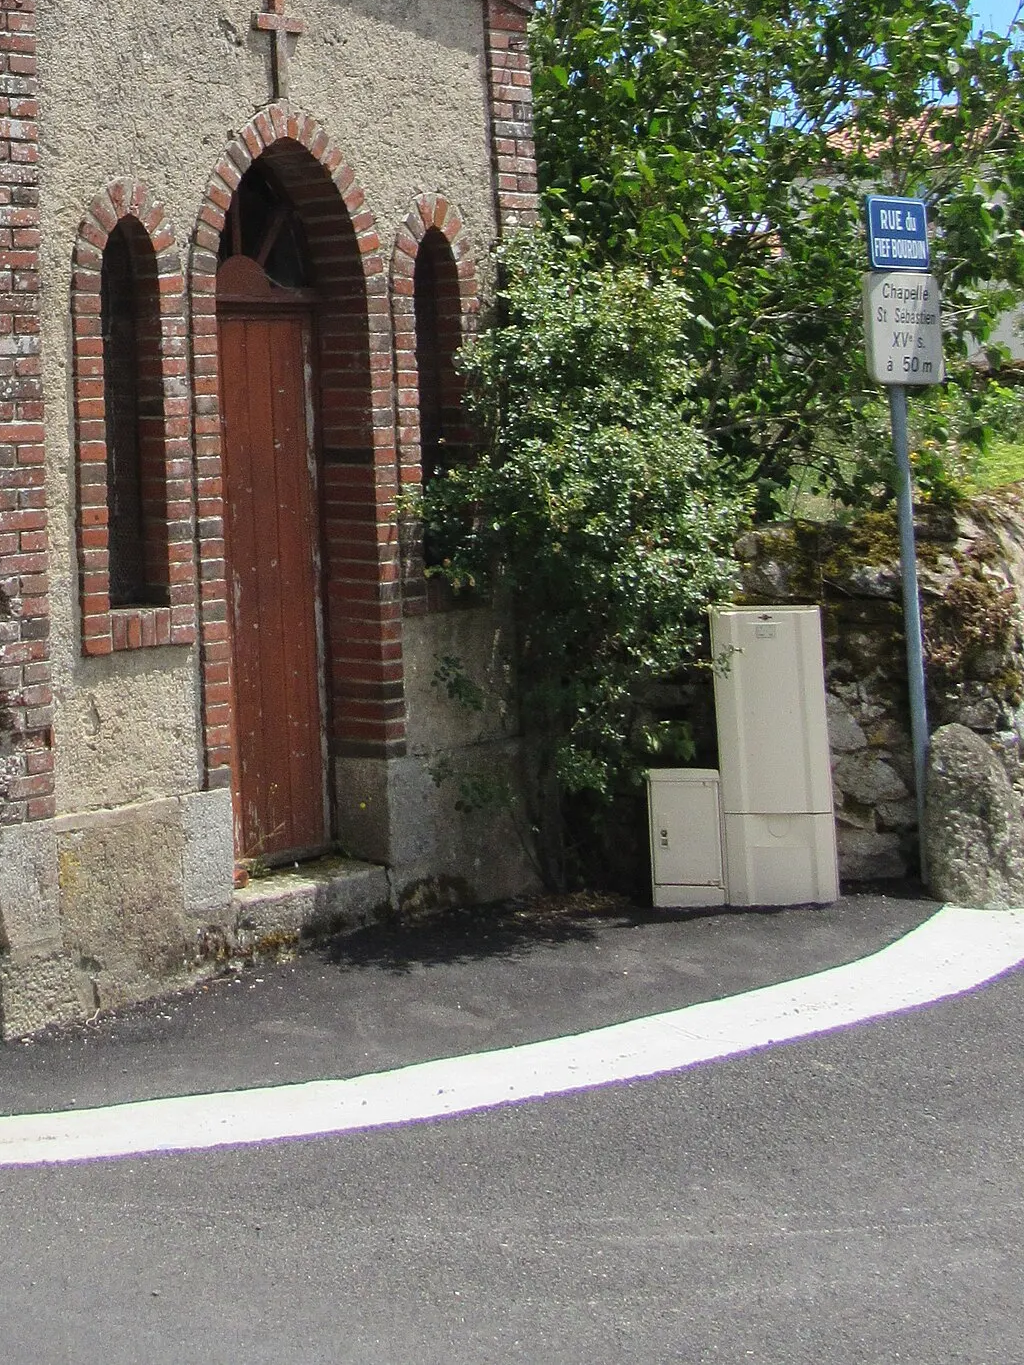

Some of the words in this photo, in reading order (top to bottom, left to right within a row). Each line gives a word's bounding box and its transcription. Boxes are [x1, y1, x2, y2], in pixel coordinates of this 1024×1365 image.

[880, 209, 903, 230] RUE
[906, 211, 916, 231] du
[874, 238, 890, 257] FIEF
[891, 238, 926, 259] BOURDIN
[882, 283, 929, 303] Chapelle
[877, 306, 887, 322] St
[894, 307, 935, 324] Sébastien
[887, 356, 893, 372] à
